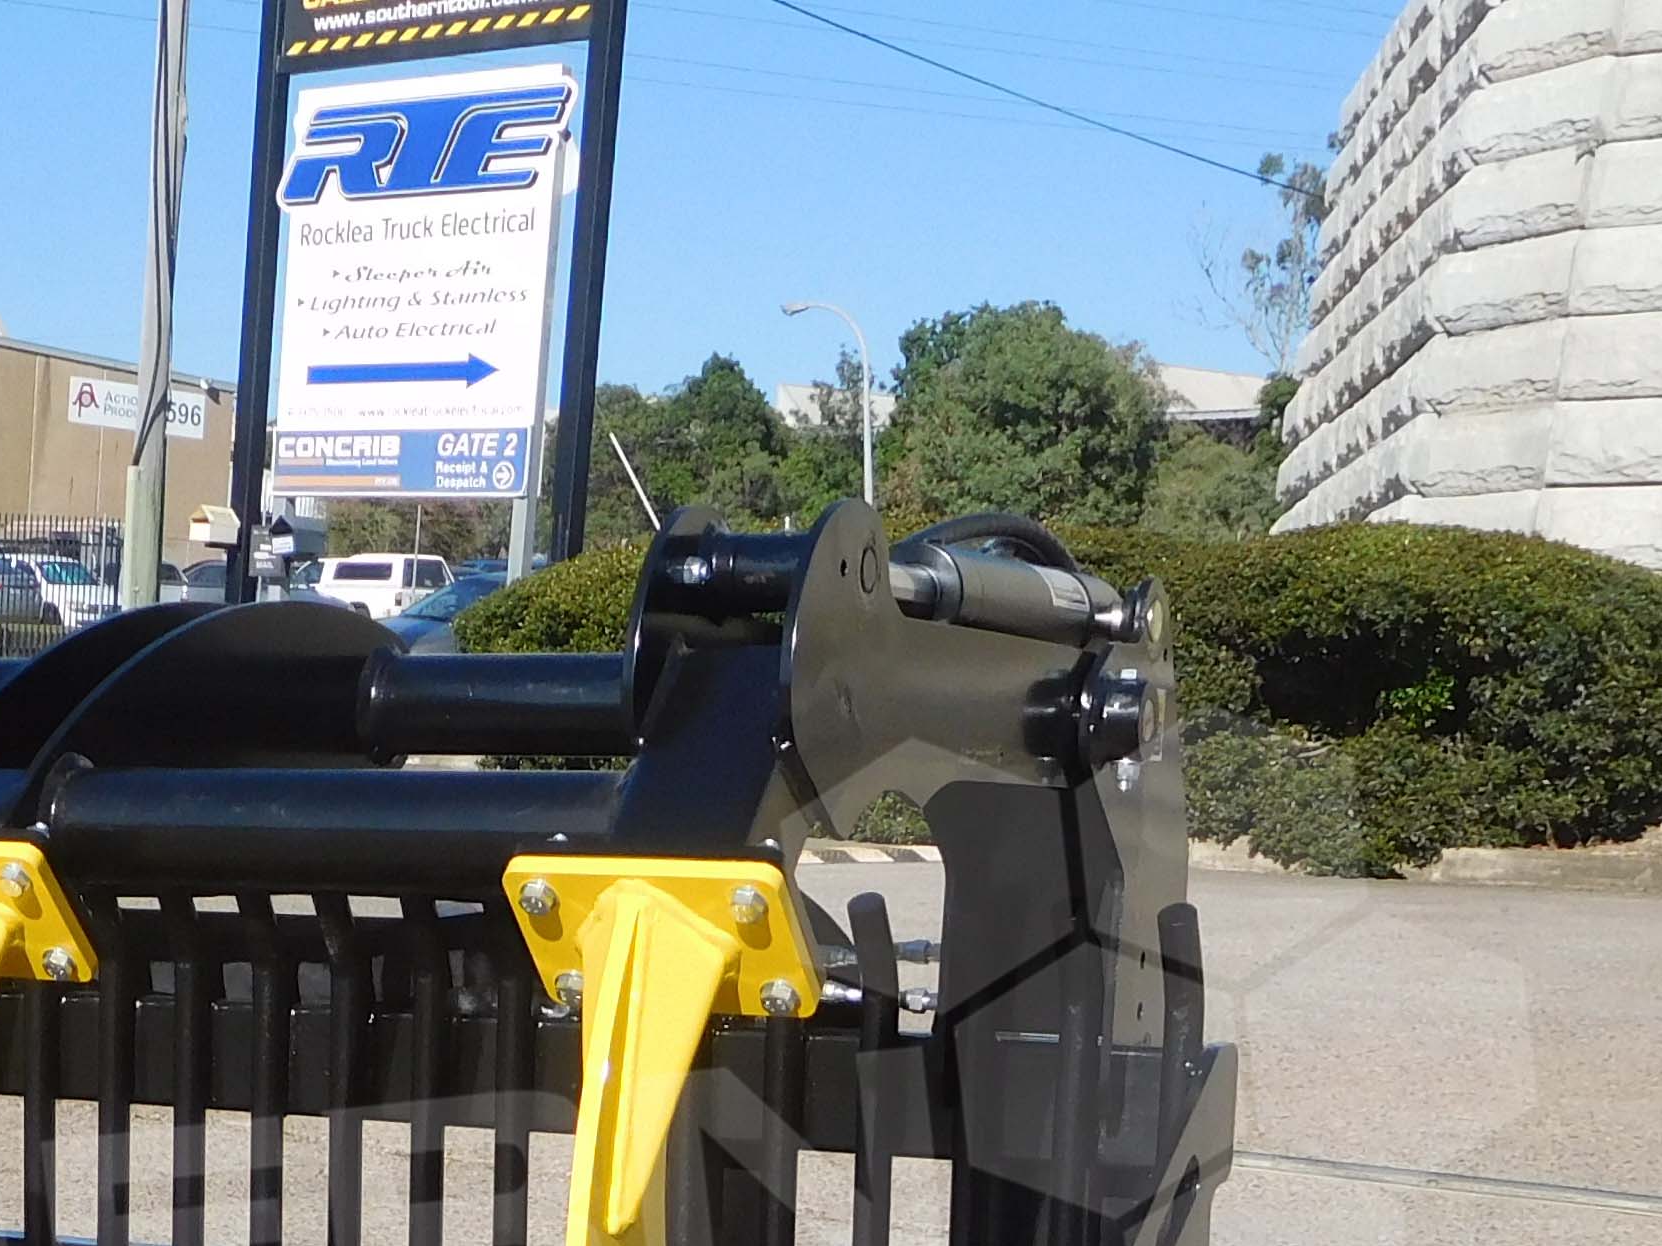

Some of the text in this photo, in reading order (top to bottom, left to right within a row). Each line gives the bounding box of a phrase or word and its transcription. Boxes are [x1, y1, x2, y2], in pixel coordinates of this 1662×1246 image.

[282, 83, 571, 206] RTE
[301, 207, 536, 247] Rocklea Truck Electrical
[344, 259, 491, 283] Sleeper Air
[309, 287, 528, 314] Lighting & Stainless
[334, 318, 497, 341] Auto Electrical
[104, 390, 138, 406] ACTIO
[278, 432, 518, 459] CONCRIB GATE 2
[436, 460, 476, 475] Receipt
[436, 475, 487, 490] Despatch
